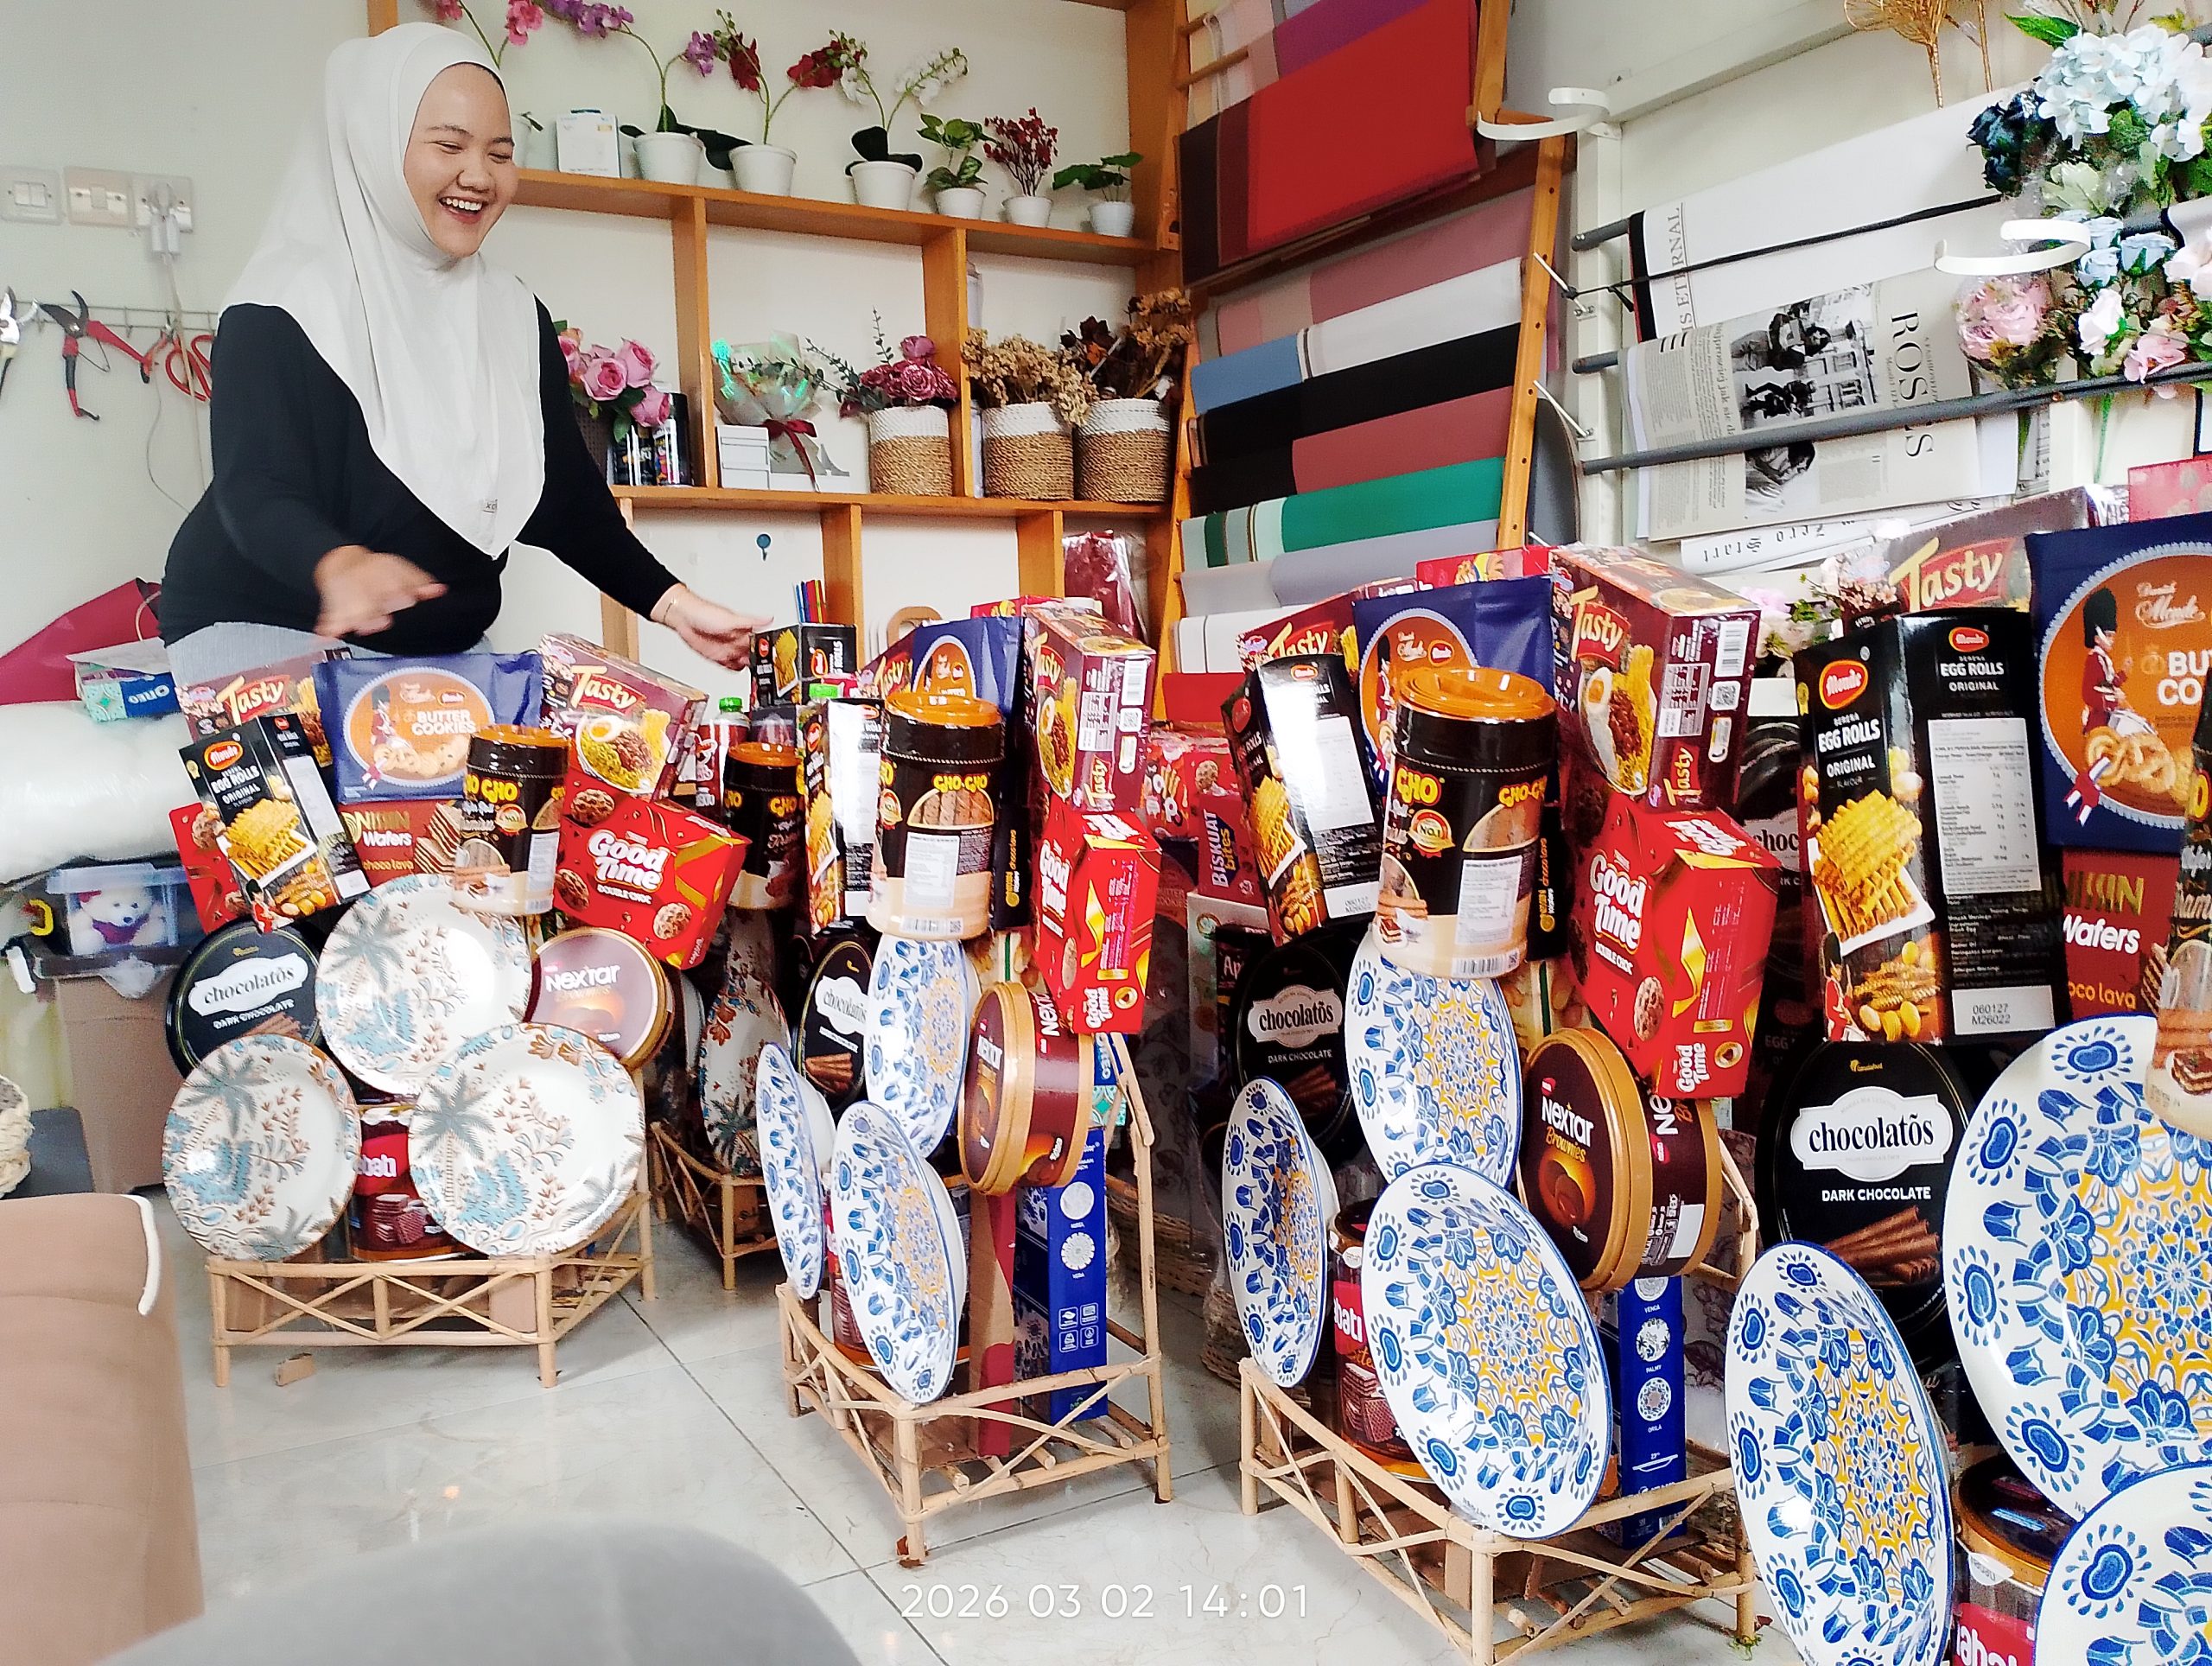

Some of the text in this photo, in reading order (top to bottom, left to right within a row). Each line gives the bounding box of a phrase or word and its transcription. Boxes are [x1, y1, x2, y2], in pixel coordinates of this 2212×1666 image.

[1891, 311, 1935, 457] ROSS
[1889, 537, 2003, 614] Tasty
[1268, 622, 1329, 658] Tasty
[1570, 585, 1624, 663] Tasty
[1940, 662, 2005, 677] EGG ROLLS
[2168, 650, 2212, 677] BU
[216, 676, 283, 726] Tasty
[570, 665, 637, 709] Tasty
[1948, 681, 1999, 692] ORIGINAL
[411, 721, 476, 735] COOKIES
[416, 709, 471, 722] BUTTER
[1818, 718, 1881, 754] EGG ROLLS
[1084, 760, 1116, 807] Tasty
[1395, 766, 1438, 804] CHO
[1663, 747, 1702, 806] Tasty
[1826, 754, 1876, 778] ORIGINAL
[222, 783, 261, 805] ORIGINAL
[362, 830, 412, 847] Wafers
[588, 830, 671, 873] Good
[1203, 808, 1230, 888] BISKUAT
[1220, 827, 1236, 871] bites
[594, 856, 664, 891] Time
[1590, 854, 1646, 919] Good
[1594, 893, 1641, 950] Time
[2099, 982, 2137, 1009] lava
[1268, 1048, 1332, 1064] DARK CHOCOLATE
[1675, 1044, 1696, 1093] Good
[1546, 1126, 1587, 1164] Brownies
[1821, 1186, 1932, 1202] DARK CHOCOLATE
